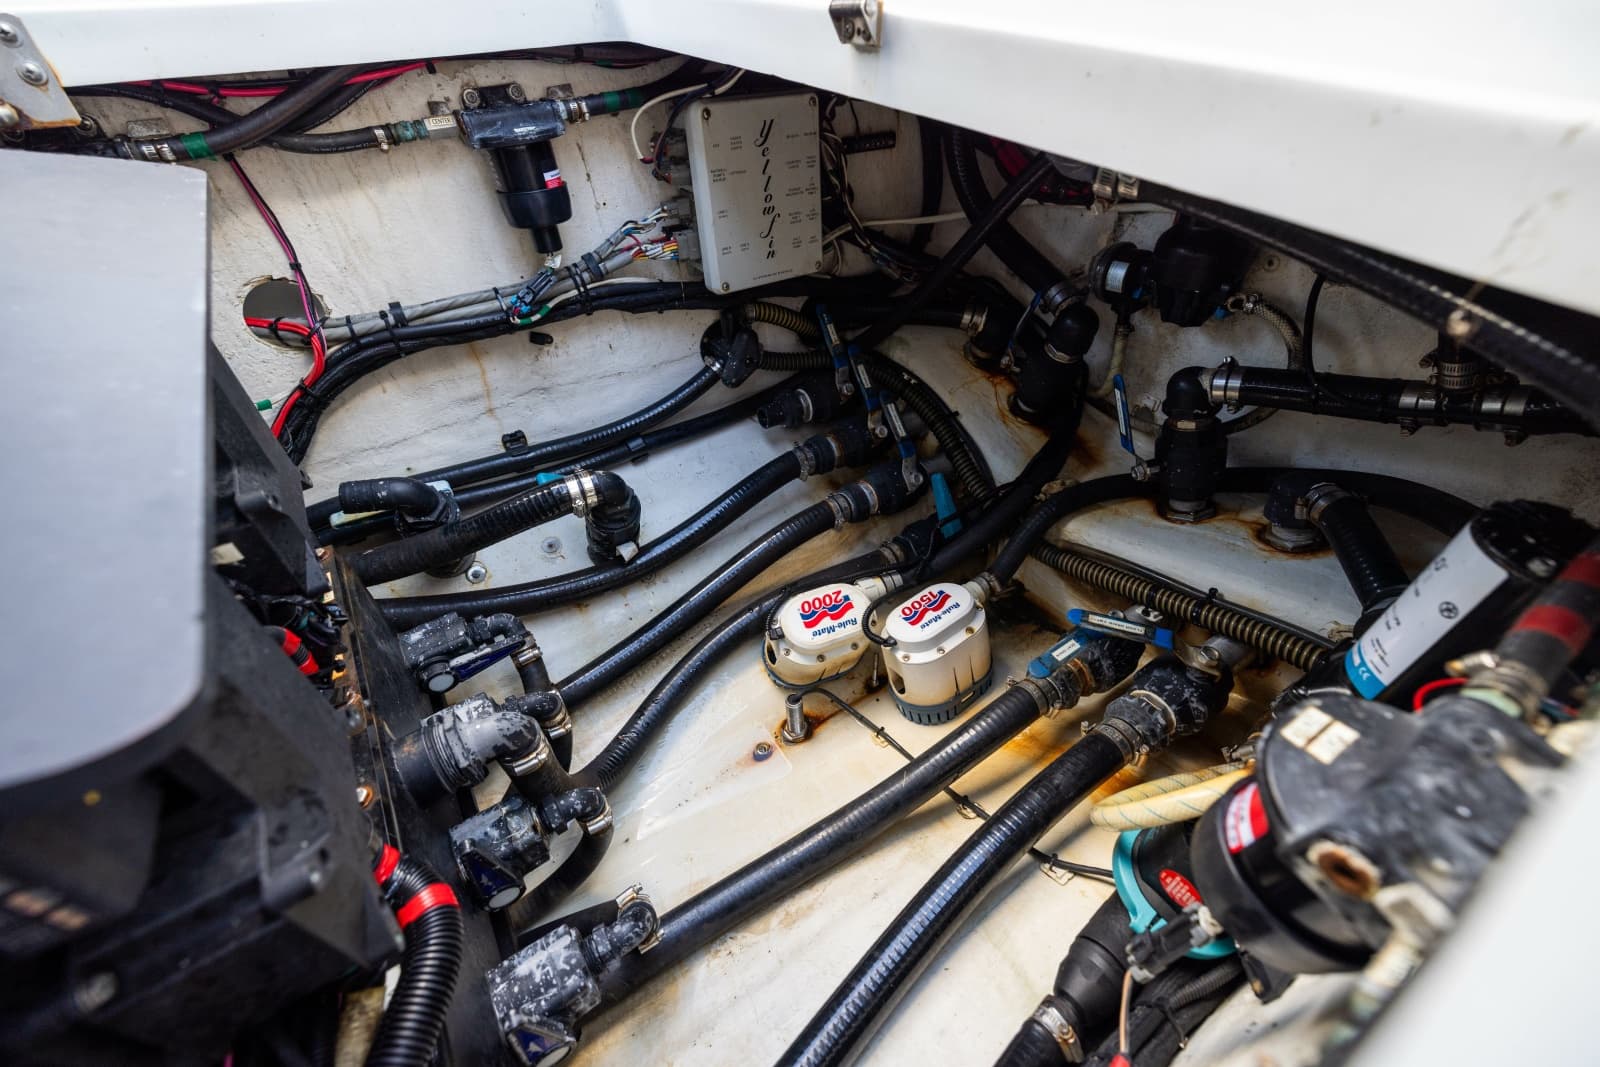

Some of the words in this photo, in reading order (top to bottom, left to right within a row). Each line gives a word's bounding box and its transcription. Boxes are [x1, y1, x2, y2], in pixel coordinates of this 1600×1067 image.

[753, 118, 781, 260] Yellowfin
[801, 590, 843, 614] 2000
[901, 590, 939, 617] 1500
[811, 616, 859, 638] Rule-Mate
[920, 601, 961, 631] Rule-Mate
